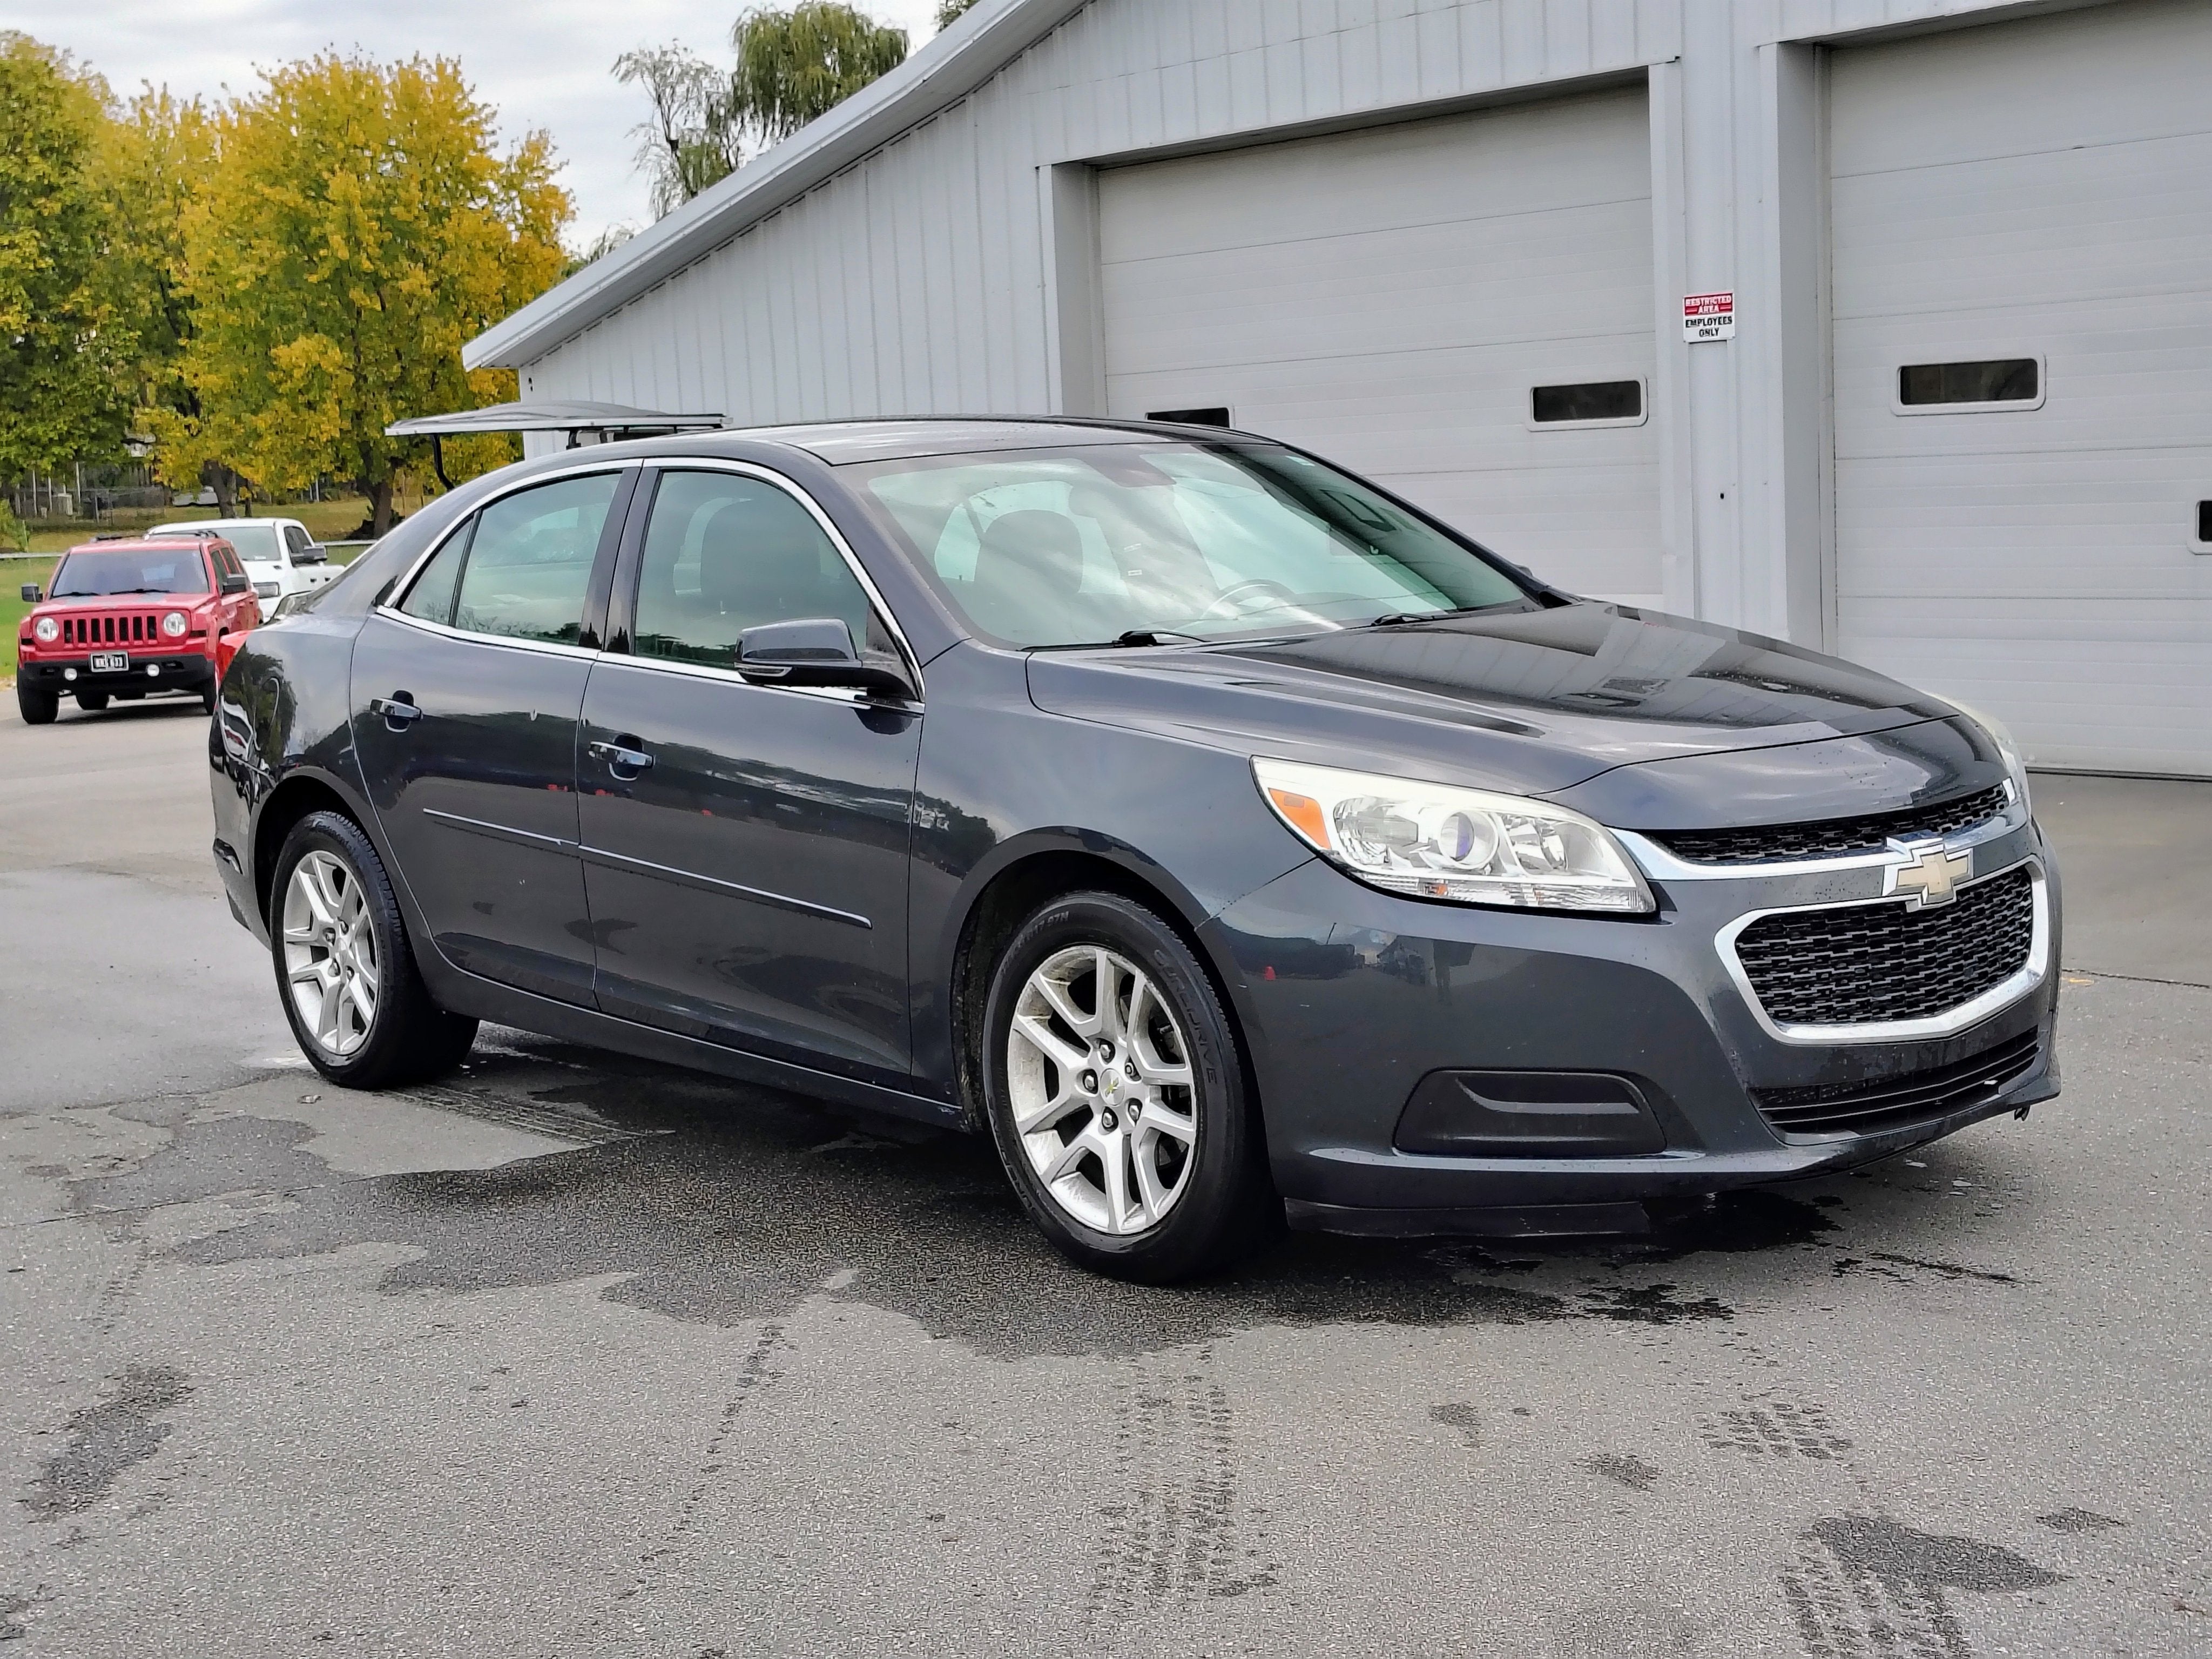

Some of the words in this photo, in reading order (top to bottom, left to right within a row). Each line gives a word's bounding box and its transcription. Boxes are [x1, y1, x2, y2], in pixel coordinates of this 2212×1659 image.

[1685, 295, 1732, 306] RESTRICTED
[1698, 305, 1719, 314] AREA
[1685, 316, 1732, 328] EMPLOYEES
[1699, 327, 1719, 337] ONLY
